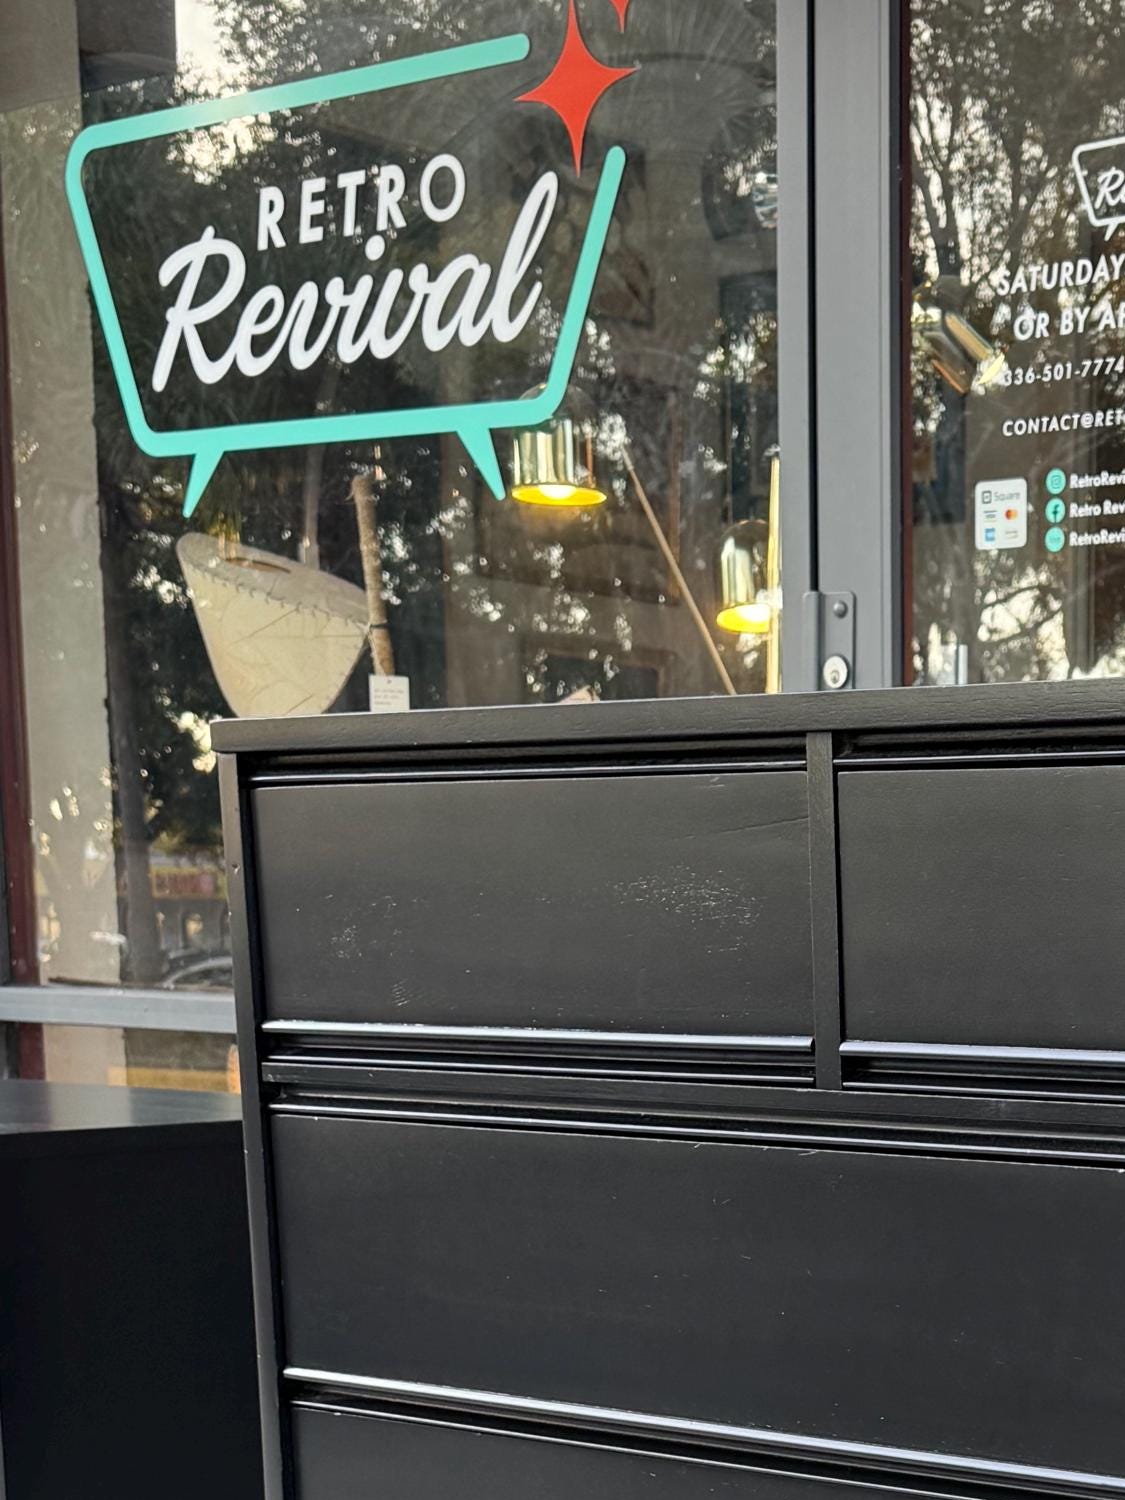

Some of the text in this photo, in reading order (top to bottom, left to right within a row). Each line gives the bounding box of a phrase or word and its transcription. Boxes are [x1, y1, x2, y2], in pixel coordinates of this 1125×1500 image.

[257, 153, 466, 251] RETRO
[152, 171, 558, 392] Revival
[1013, 310, 1049, 340] OR
[1059, 306, 1091, 336] BY
[1003, 355, 1125, 386] 336-501-7774
[1069, 502, 1101, 518] Retro
